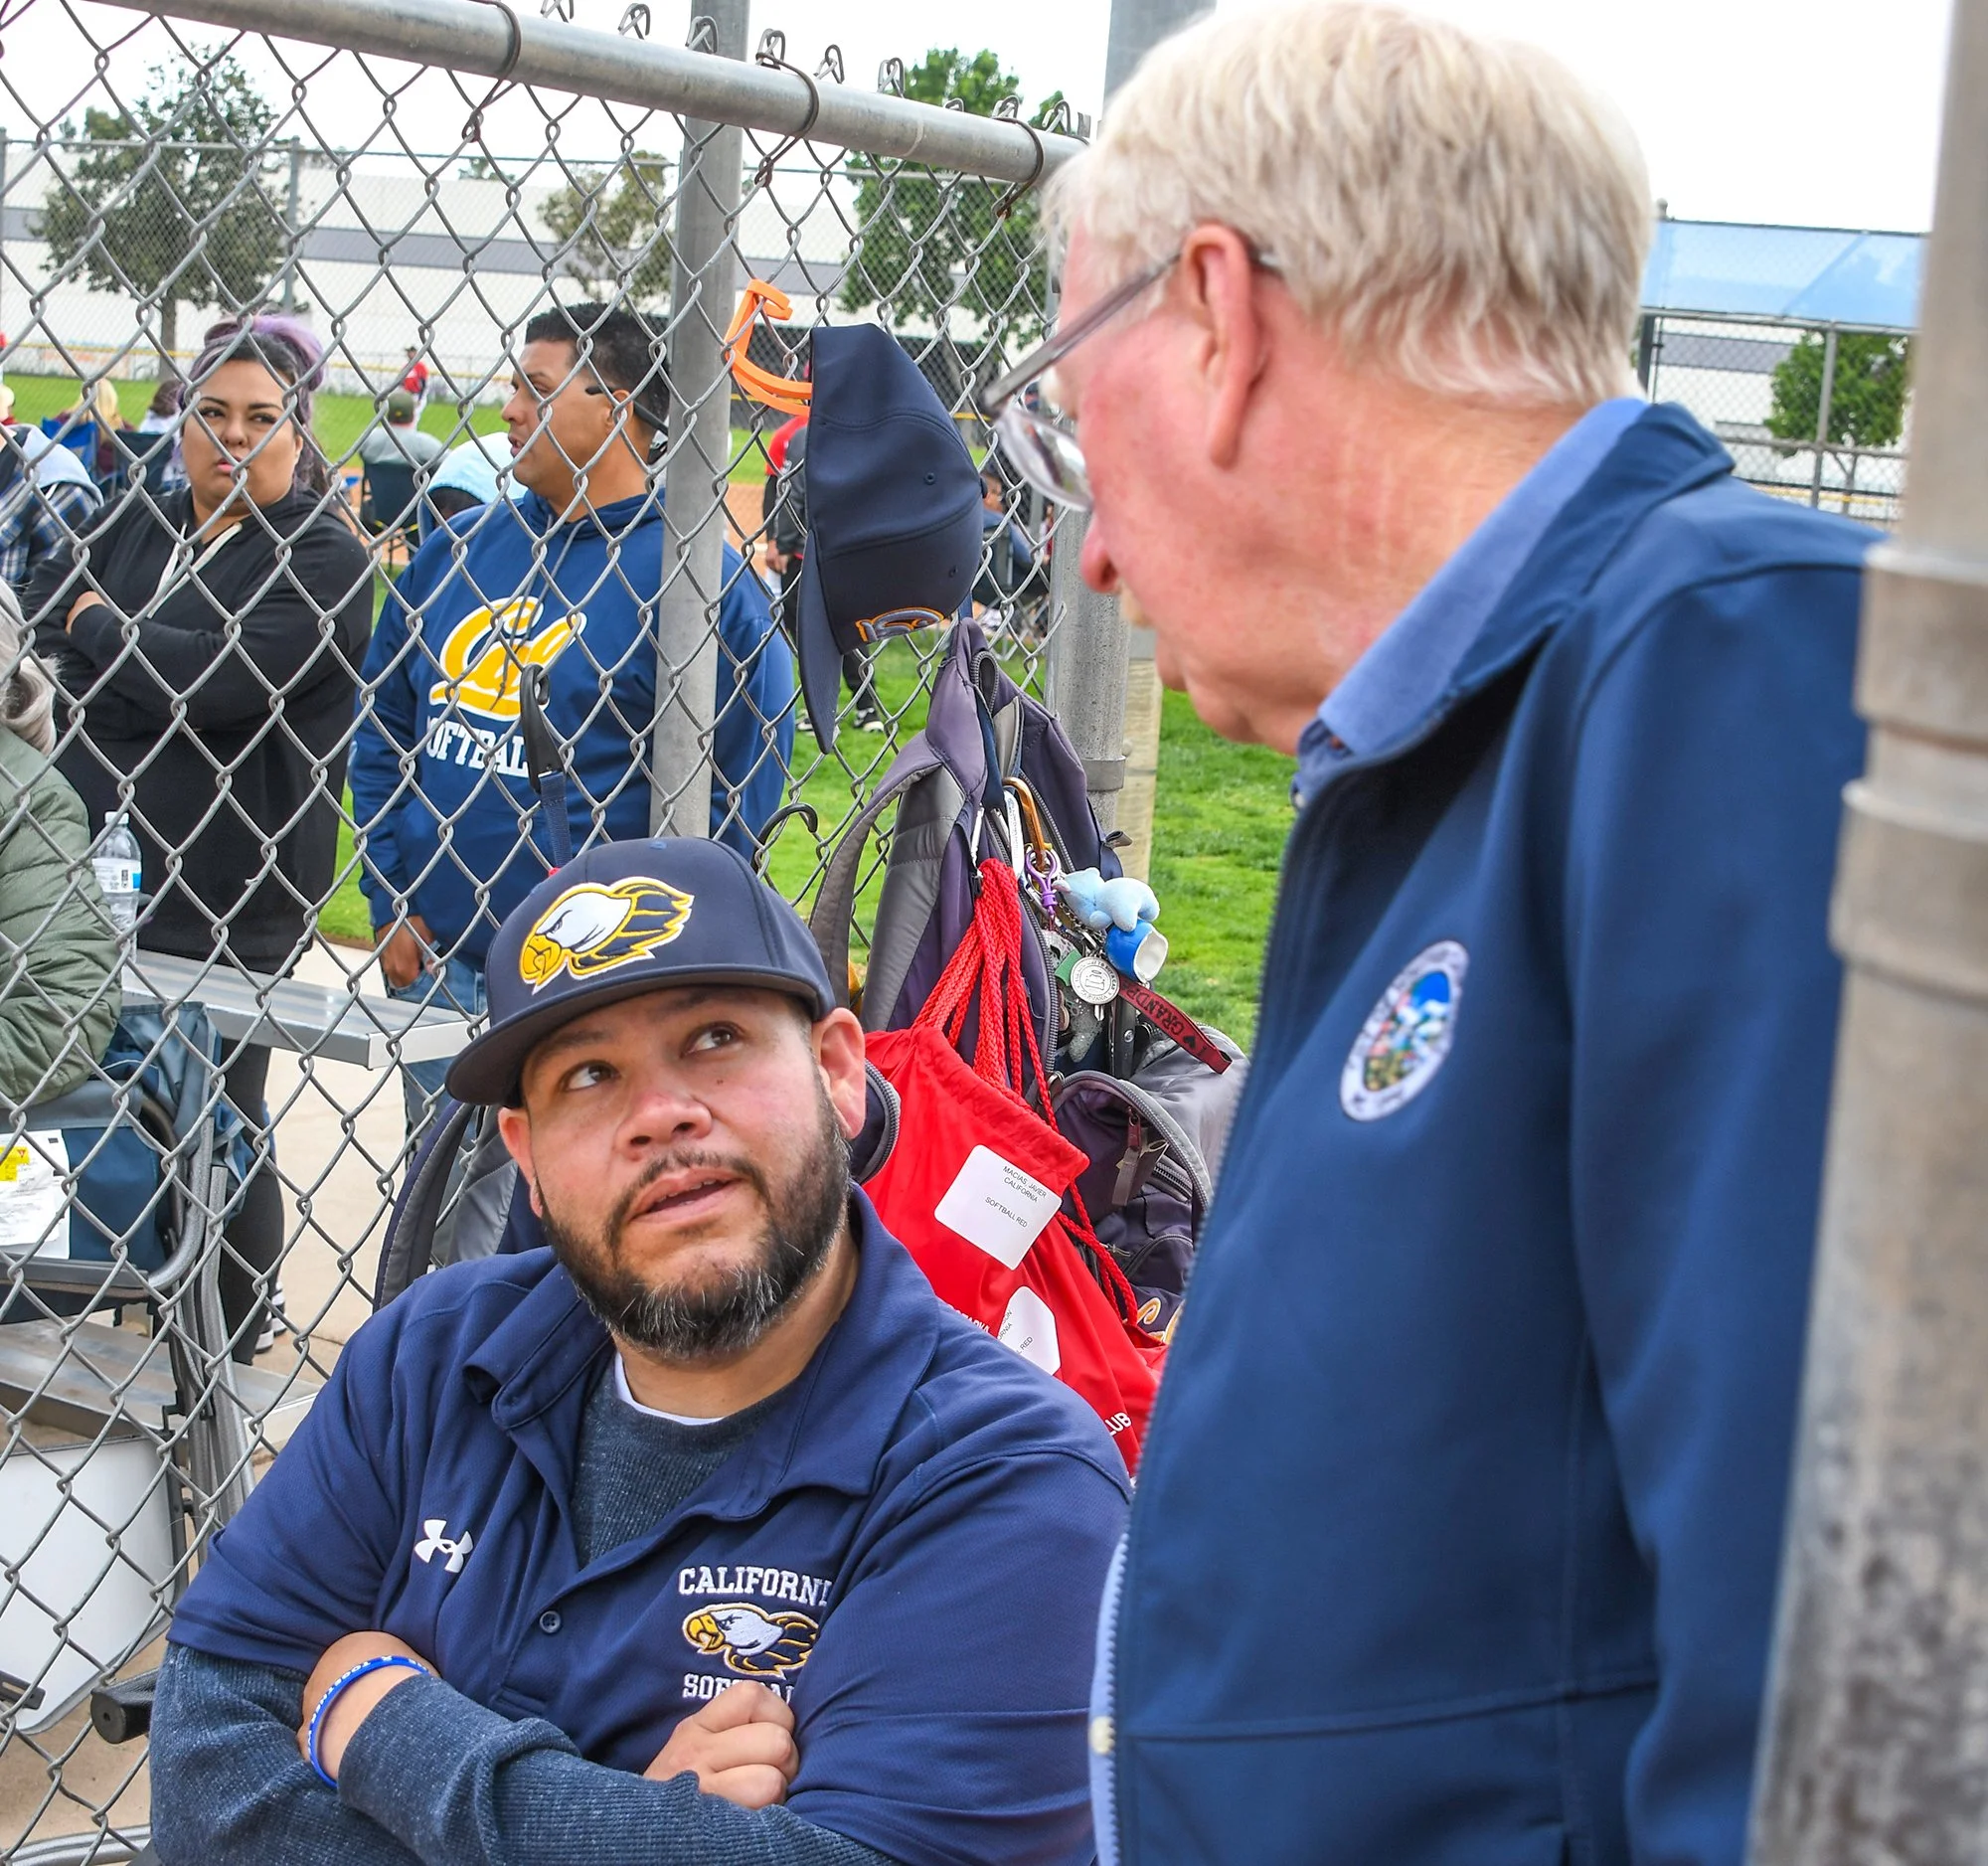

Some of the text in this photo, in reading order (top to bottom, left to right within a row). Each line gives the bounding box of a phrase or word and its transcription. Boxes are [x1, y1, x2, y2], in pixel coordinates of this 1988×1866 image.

[1003, 1165, 1048, 1198] MACIAS, JAVIER
[1004, 1177, 1038, 1203] CALIFORNIA
[985, 1196, 1028, 1228] SOFTBALL RED
[1020, 1336, 1034, 1350] RED
[678, 1565, 833, 1608] CALIFORNI
